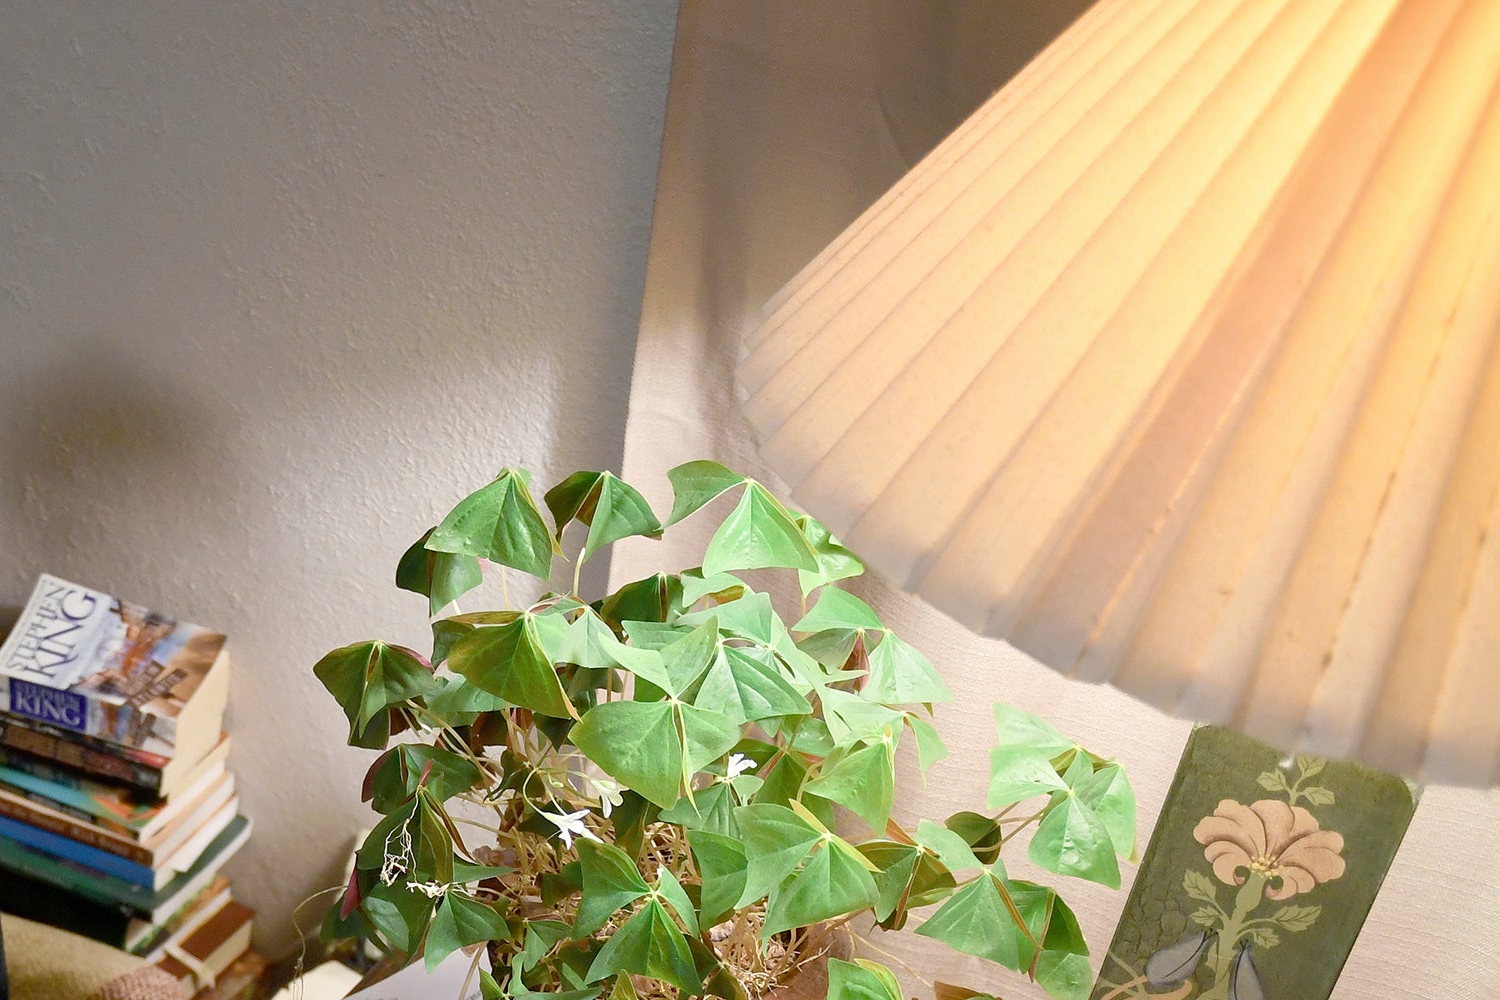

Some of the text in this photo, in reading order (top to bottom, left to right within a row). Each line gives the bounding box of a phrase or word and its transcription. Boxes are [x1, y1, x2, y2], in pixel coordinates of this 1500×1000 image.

[7, 585, 65, 672] STEPHEN
[23, 589, 98, 680] KING
[15, 693, 82, 726] KING
